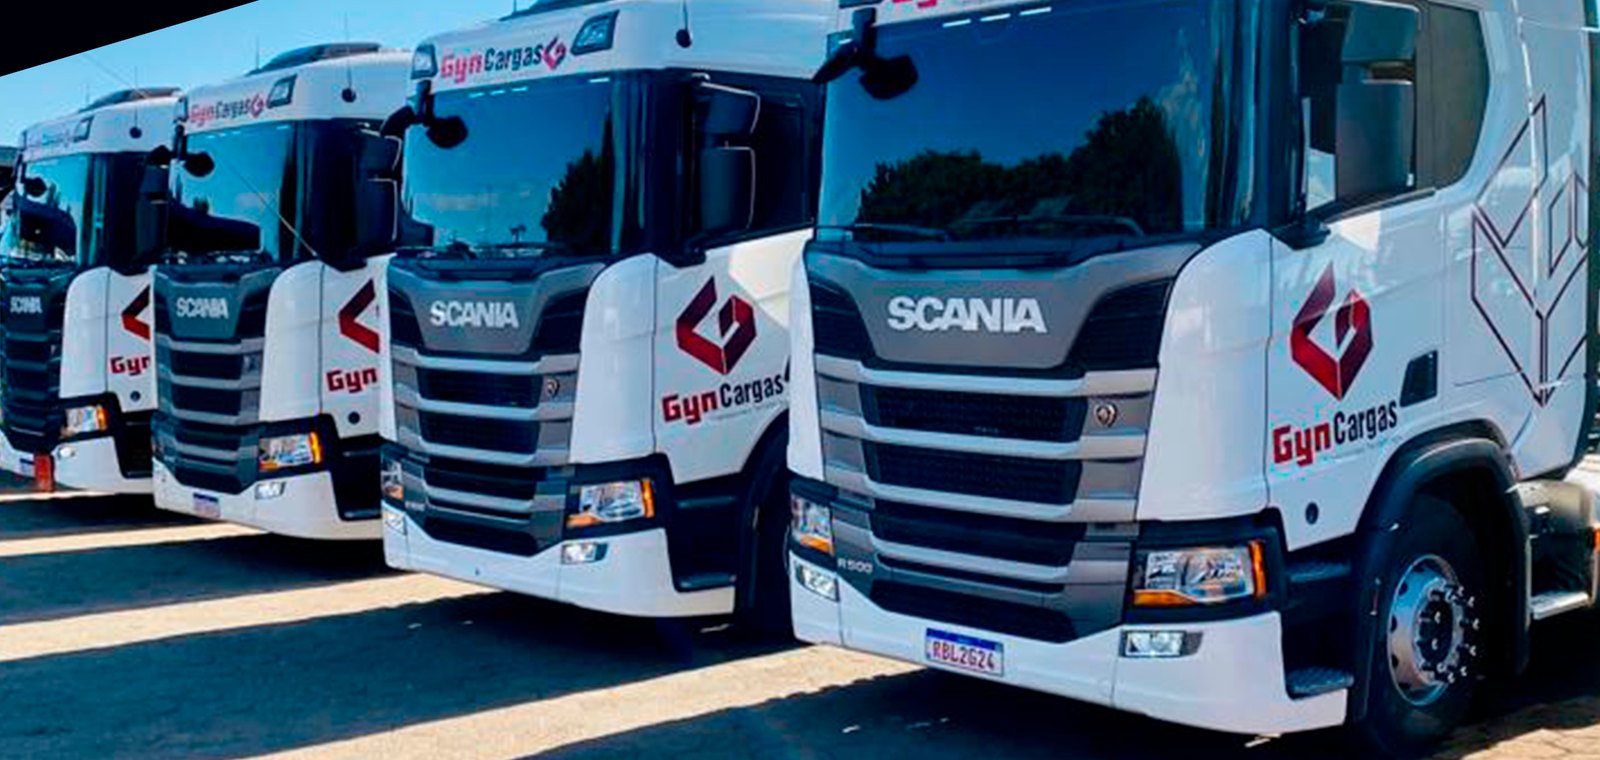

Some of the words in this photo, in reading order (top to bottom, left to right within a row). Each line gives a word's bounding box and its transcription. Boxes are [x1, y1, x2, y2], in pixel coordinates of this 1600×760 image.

[177, 296, 229, 319] SCANIA
[430, 300, 520, 329] SCANIA
[887, 295, 1048, 334] SCANIA
[326, 367, 378, 394] Gyn
